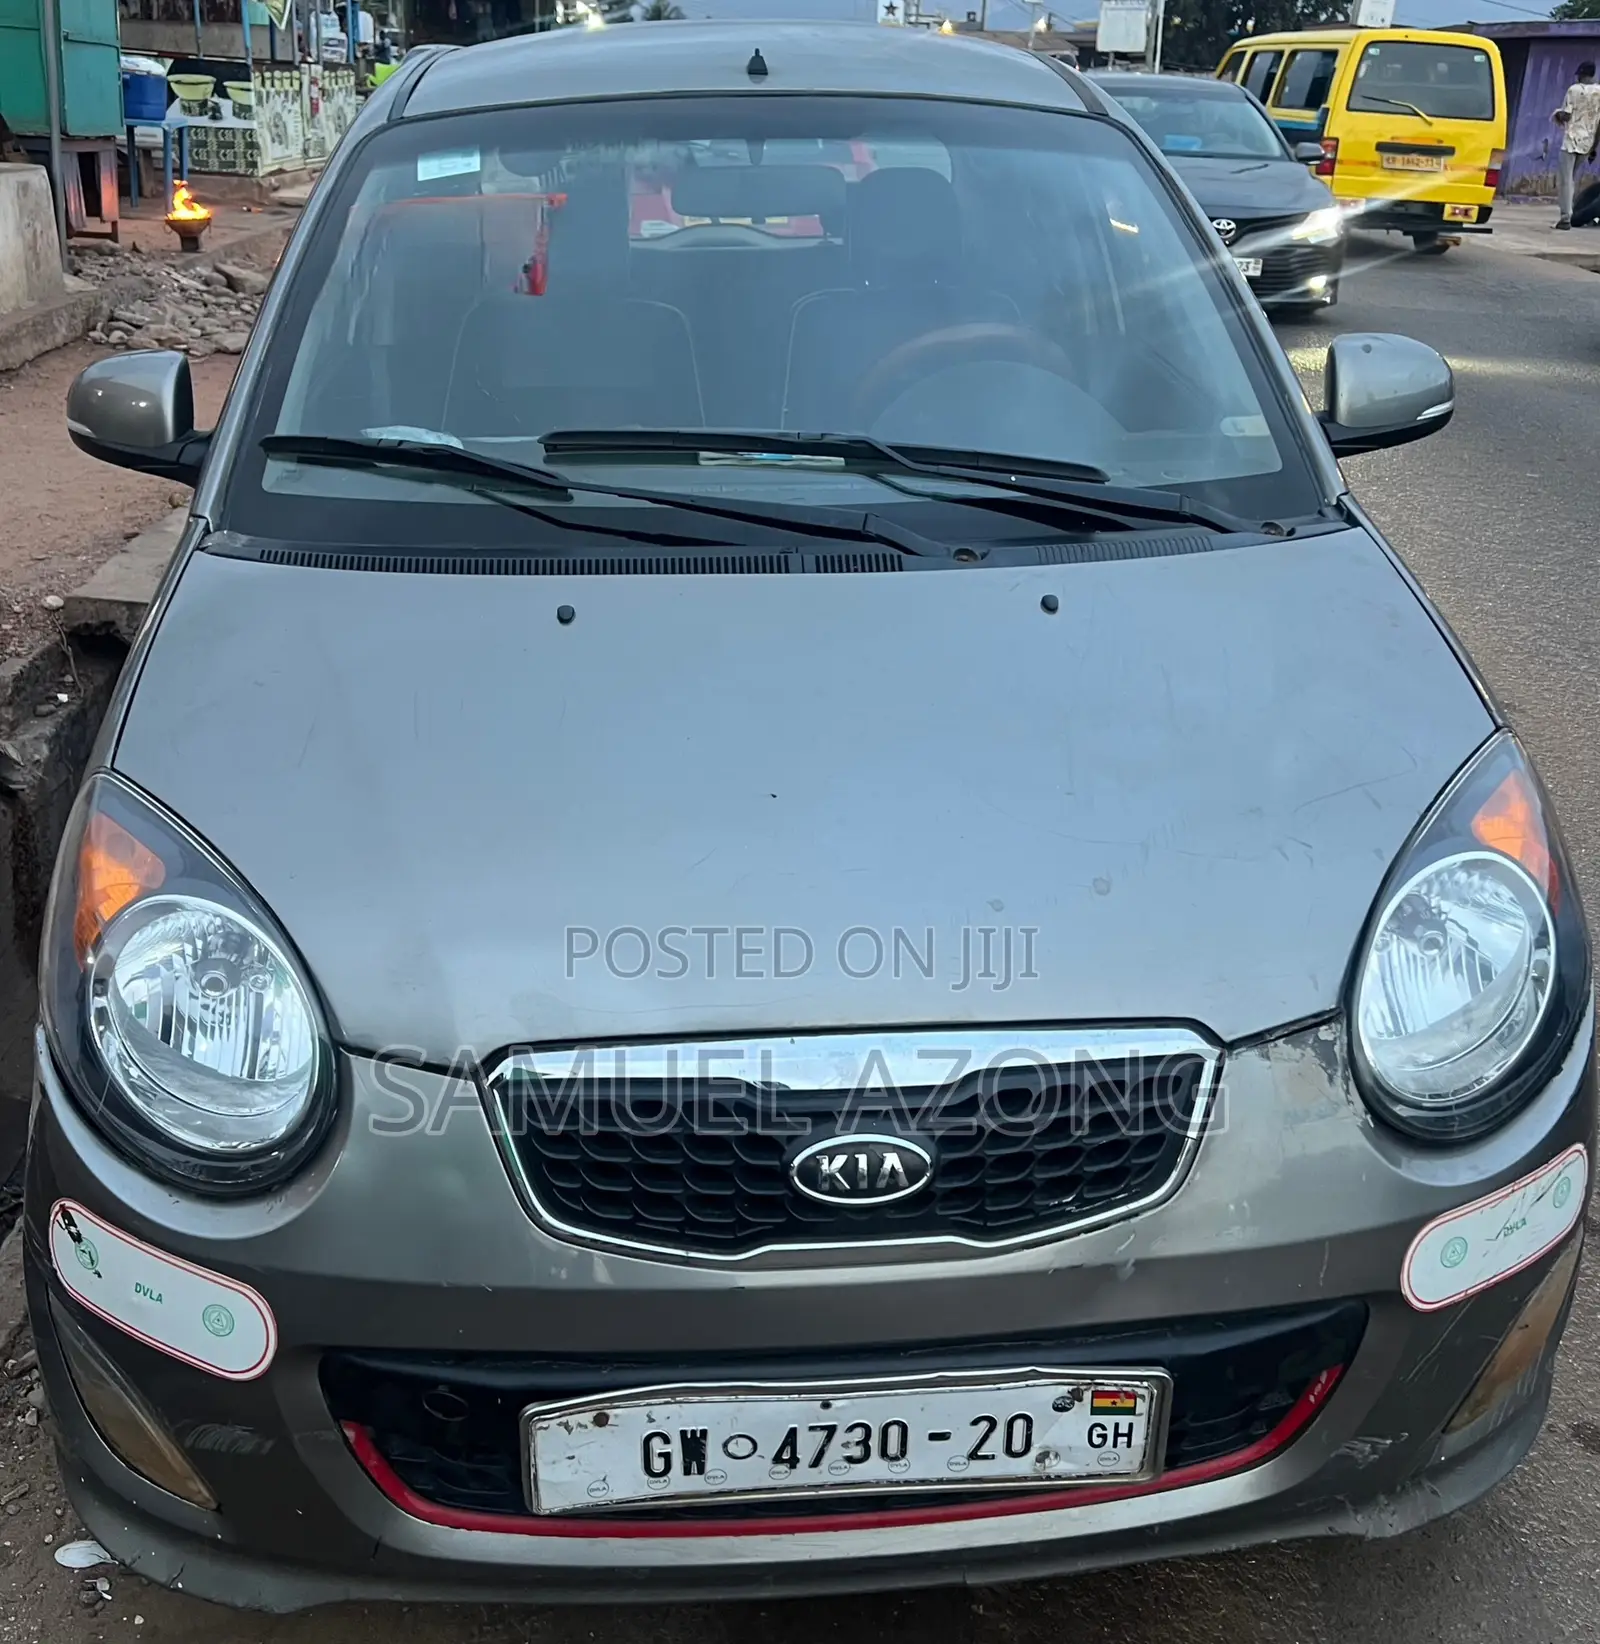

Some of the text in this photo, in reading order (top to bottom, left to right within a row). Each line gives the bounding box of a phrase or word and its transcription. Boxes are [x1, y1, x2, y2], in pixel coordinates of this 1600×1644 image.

[816, 1151, 909, 1193] KIA
[134, 1281, 163, 1304] DVLA
[641, 1427, 709, 1479] GW
[771, 1418, 909, 1470] 4730
[966, 1411, 1034, 1461] 20
[1087, 1421, 1134, 1449] GH
